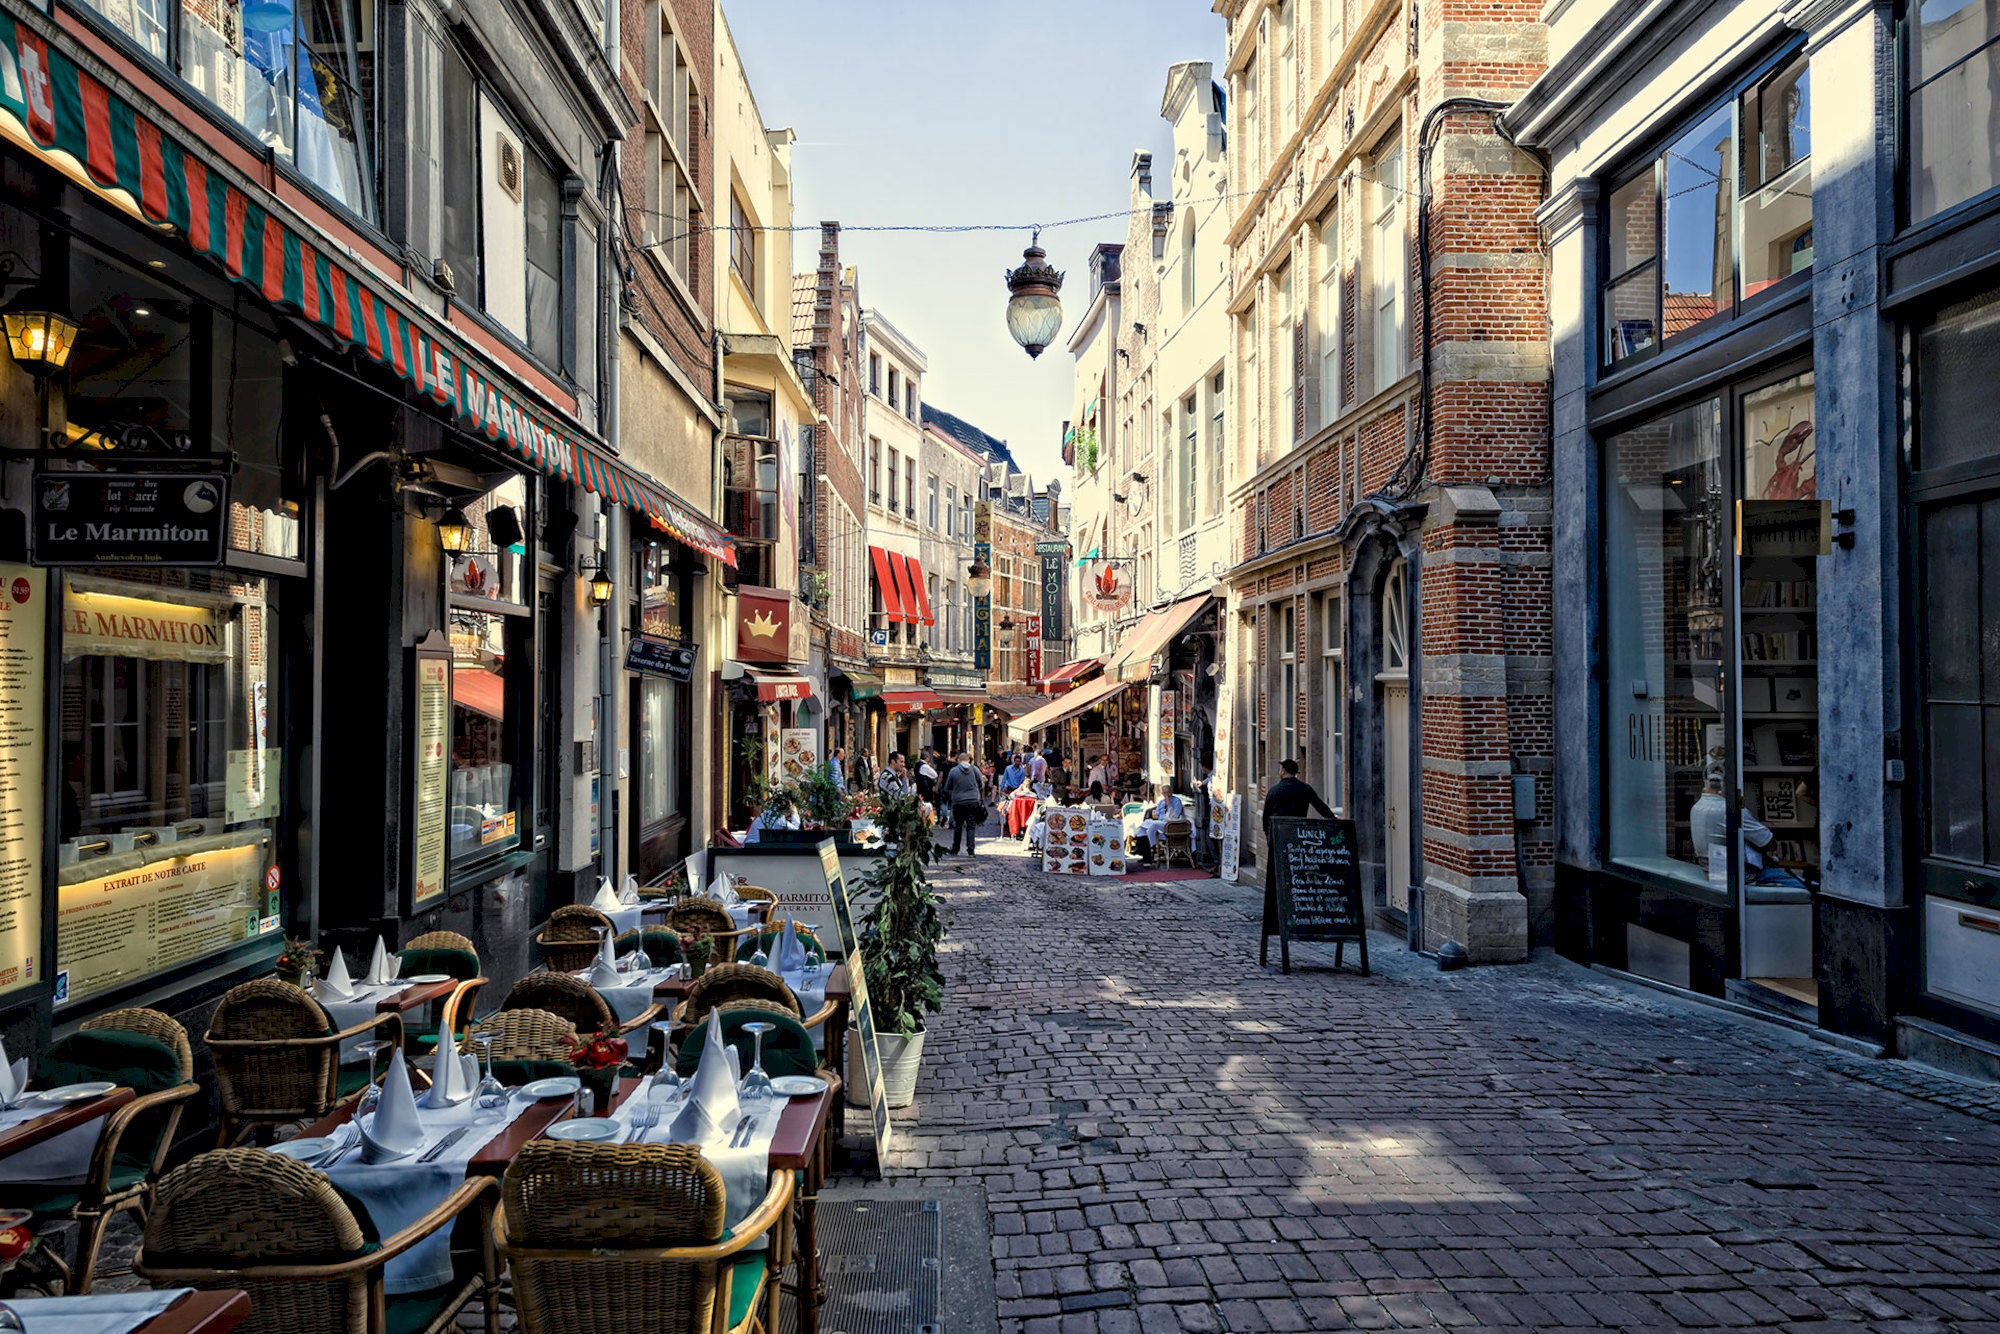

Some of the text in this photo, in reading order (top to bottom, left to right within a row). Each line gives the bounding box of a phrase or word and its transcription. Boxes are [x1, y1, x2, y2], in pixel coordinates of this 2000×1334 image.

[418, 338, 574, 475] LE MARMITON
[48, 522, 210, 542] Le Marmiton
[1046, 557, 1058, 570] LE
[1045, 573, 1059, 638] MOULIN
[64, 609, 220, 646] LE MARMITON
[876, 632, 885, 643] P
[630, 654, 654, 667] Taverne
[655, 660, 664, 668] du
[665, 662, 690, 676] Passage
[1767, 790, 1780, 820] LES
[1780, 781, 1795, 820] UNES
[1297, 828, 1326, 839] LUNCH
[103, 862, 206, 892] EXTRAIT DE NOTRE CARTE
[775, 893, 831, 902] MARMITO
